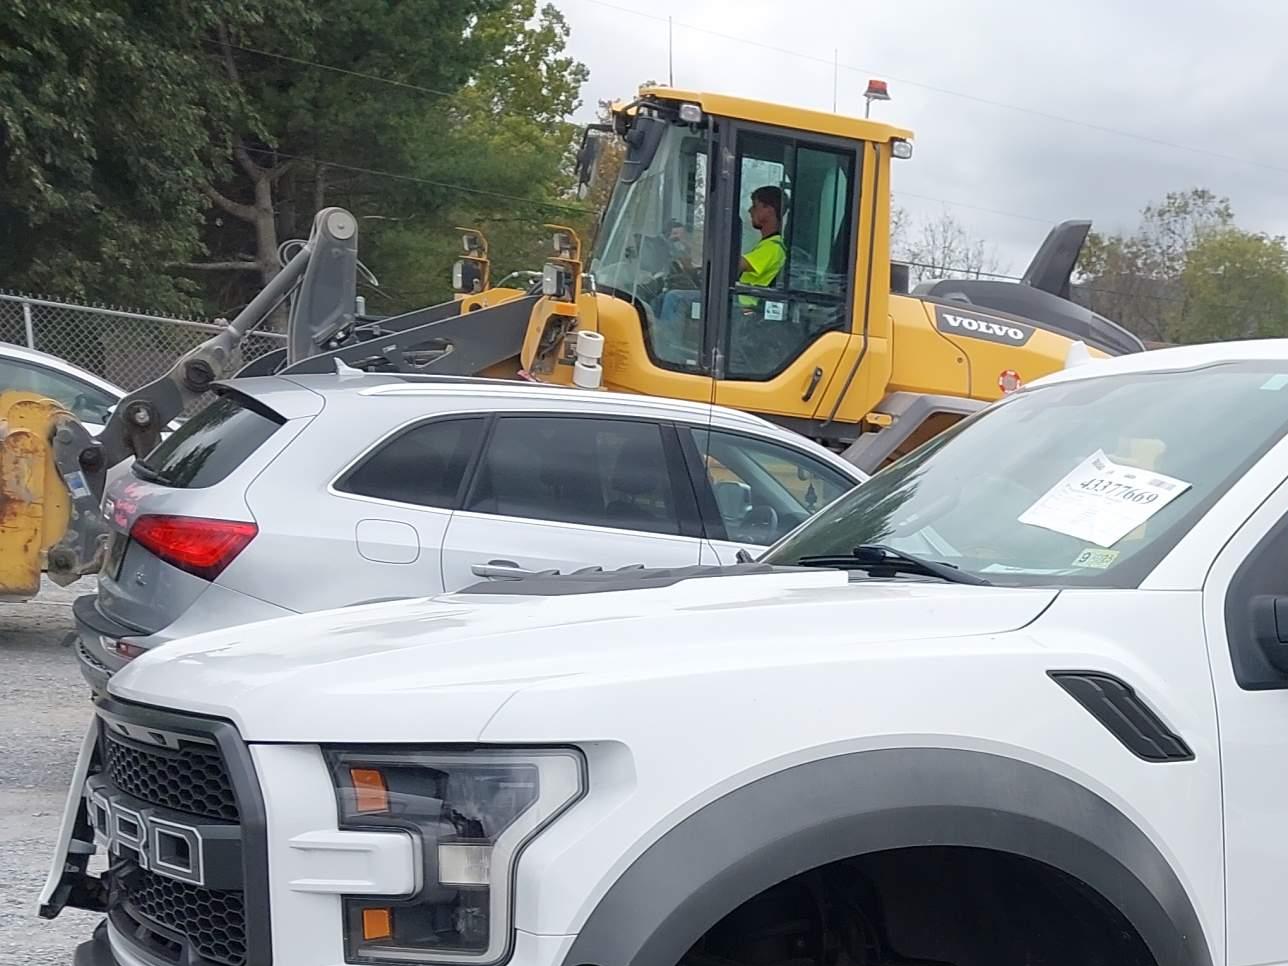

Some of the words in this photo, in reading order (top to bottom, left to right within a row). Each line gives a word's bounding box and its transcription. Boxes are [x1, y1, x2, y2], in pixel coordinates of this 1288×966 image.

[942, 313, 1025, 340] VOLVO
[1080, 478, 1159, 504] 43377669
[87, 788, 205, 886] ORD
